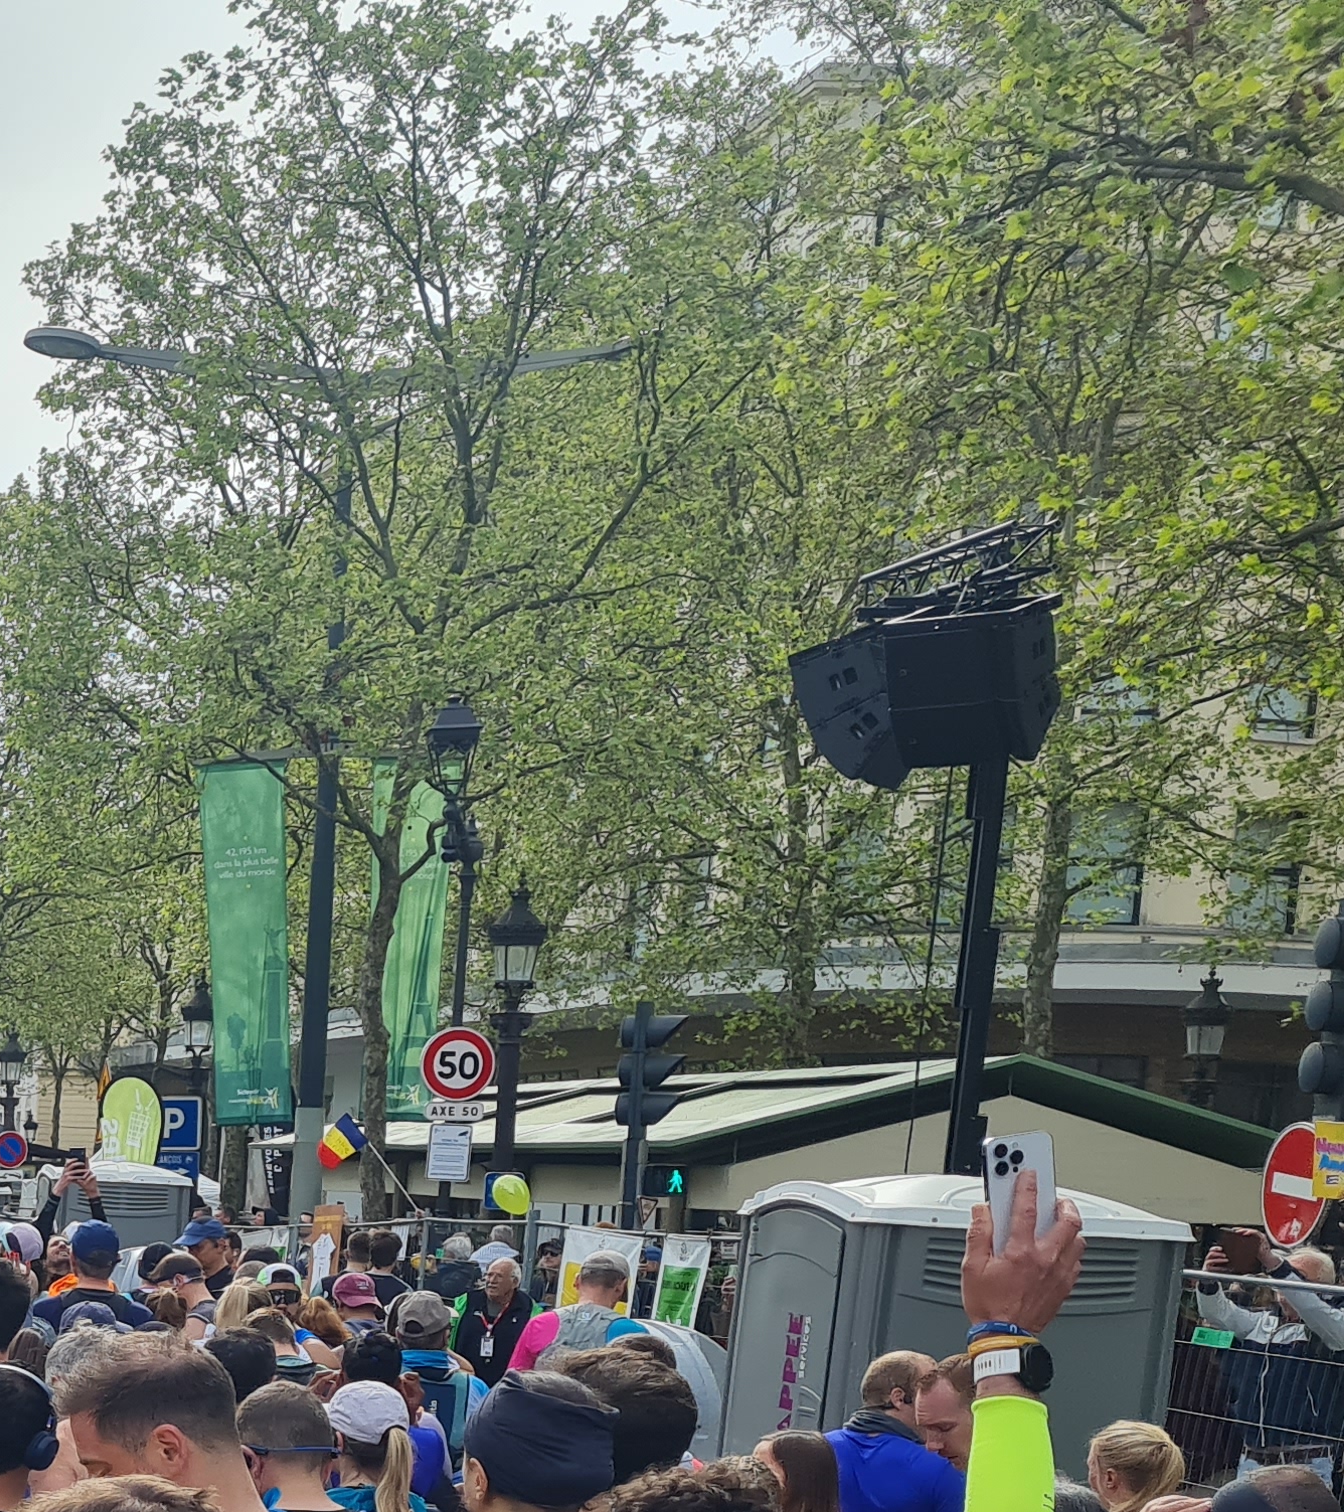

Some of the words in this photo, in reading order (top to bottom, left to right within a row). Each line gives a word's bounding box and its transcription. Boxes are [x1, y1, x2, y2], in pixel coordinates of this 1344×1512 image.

[438, 1051, 480, 1080] 50
[430, 1106, 455, 1117] AXE
[461, 1106, 479, 1117] 50
[164, 1108, 185, 1138] P
[159, 1154, 182, 1164] ANÇOIS
